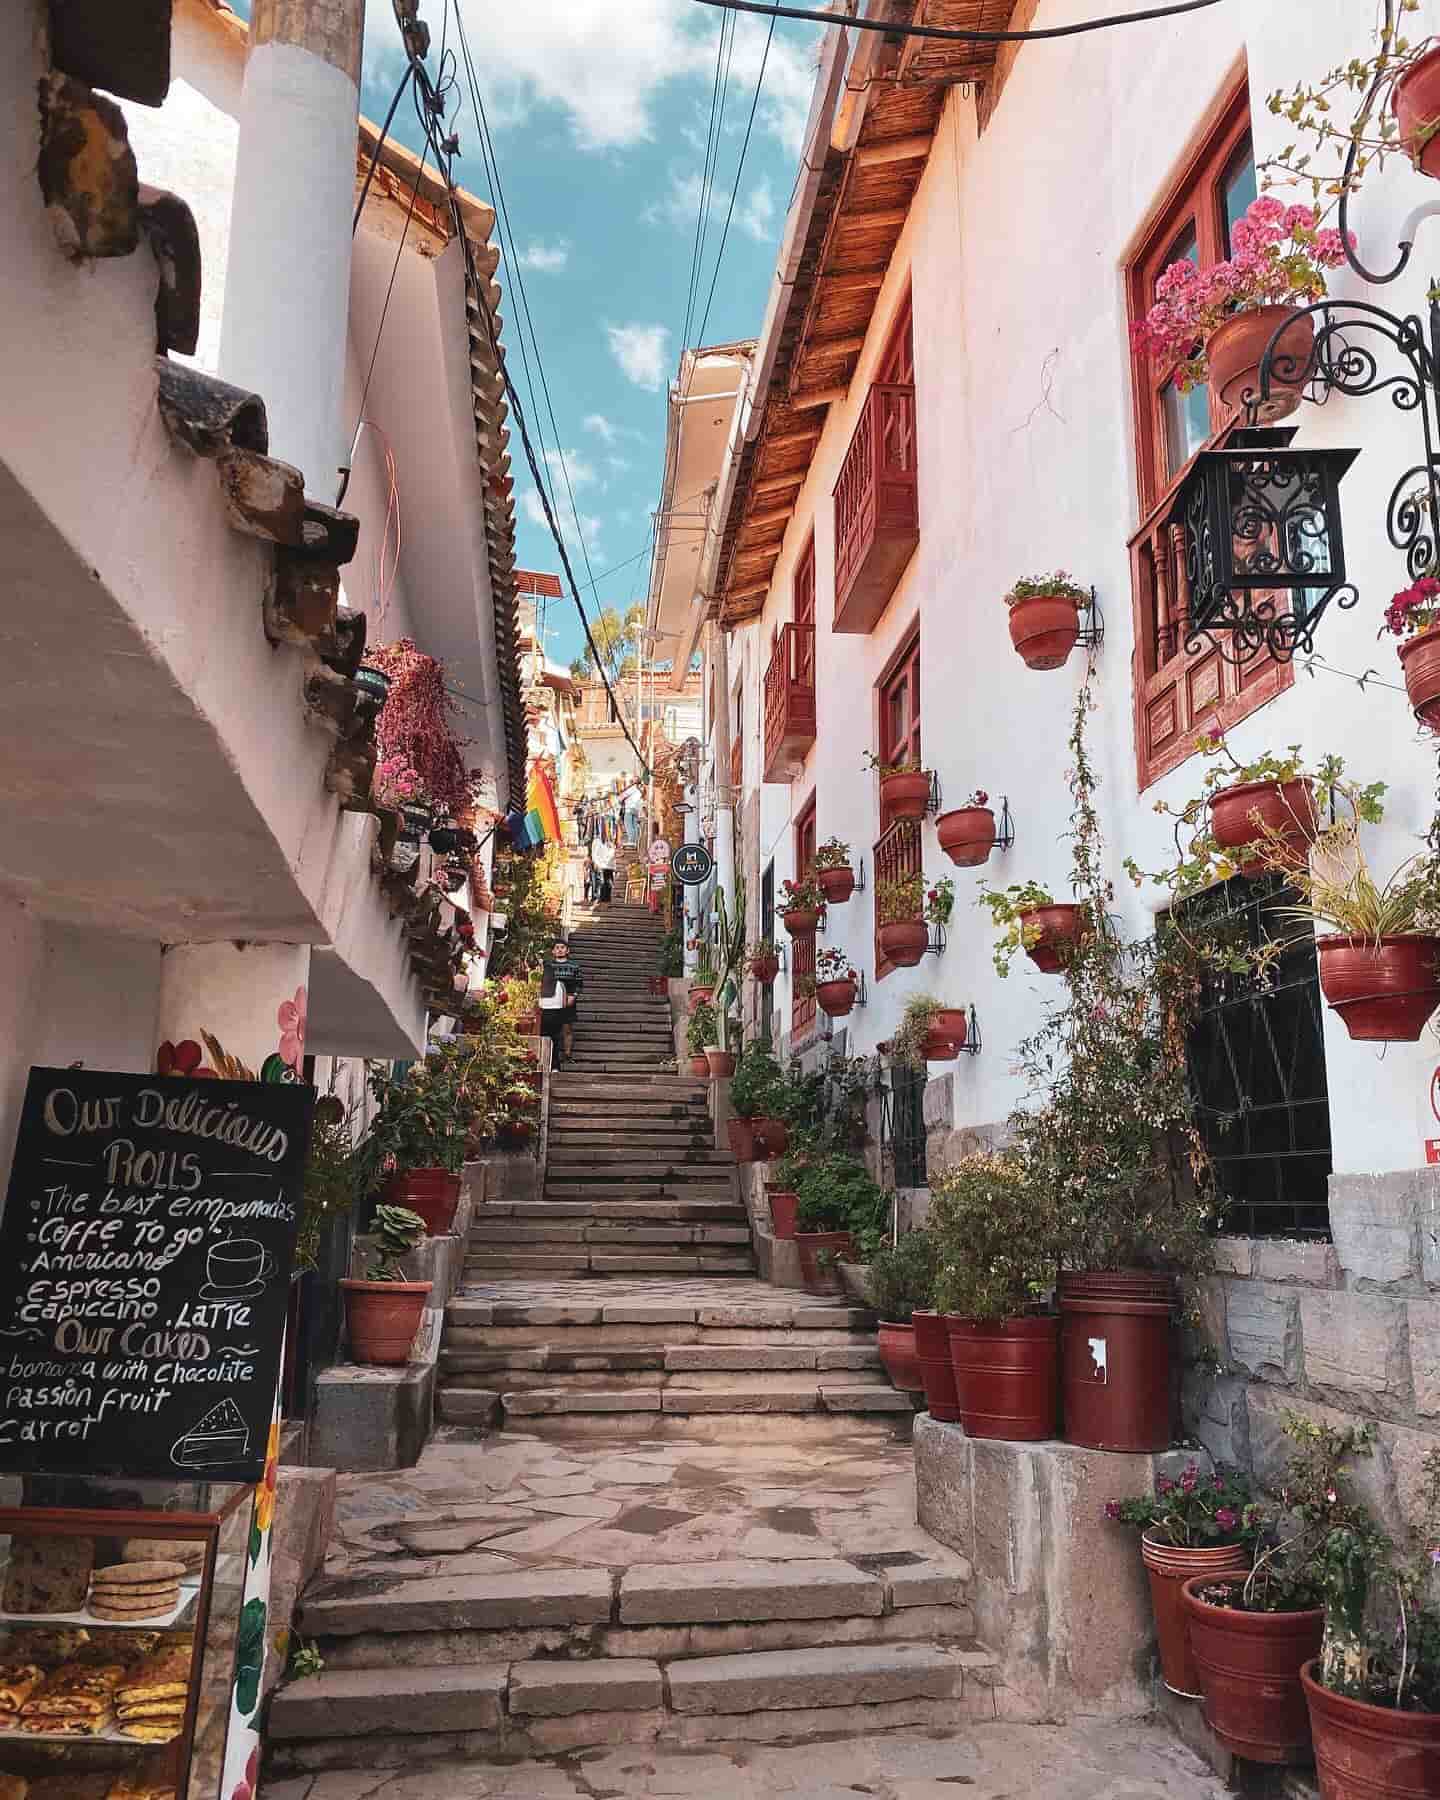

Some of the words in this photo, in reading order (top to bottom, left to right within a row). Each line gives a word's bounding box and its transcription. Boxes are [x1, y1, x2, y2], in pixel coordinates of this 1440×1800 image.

[44, 1088, 121, 1136] Our
[131, 1089, 288, 1162] Delicious
[44, 1184, 90, 1215] The
[99, 1188, 165, 1216] best
[163, 1226, 204, 1259] go
[29, 1250, 175, 1273] Americano
[26, 1278, 161, 1304] Espresso
[54, 1319, 115, 1353] Our
[102, 1359, 149, 1381] with
[97, 1387, 172, 1423] fruit
